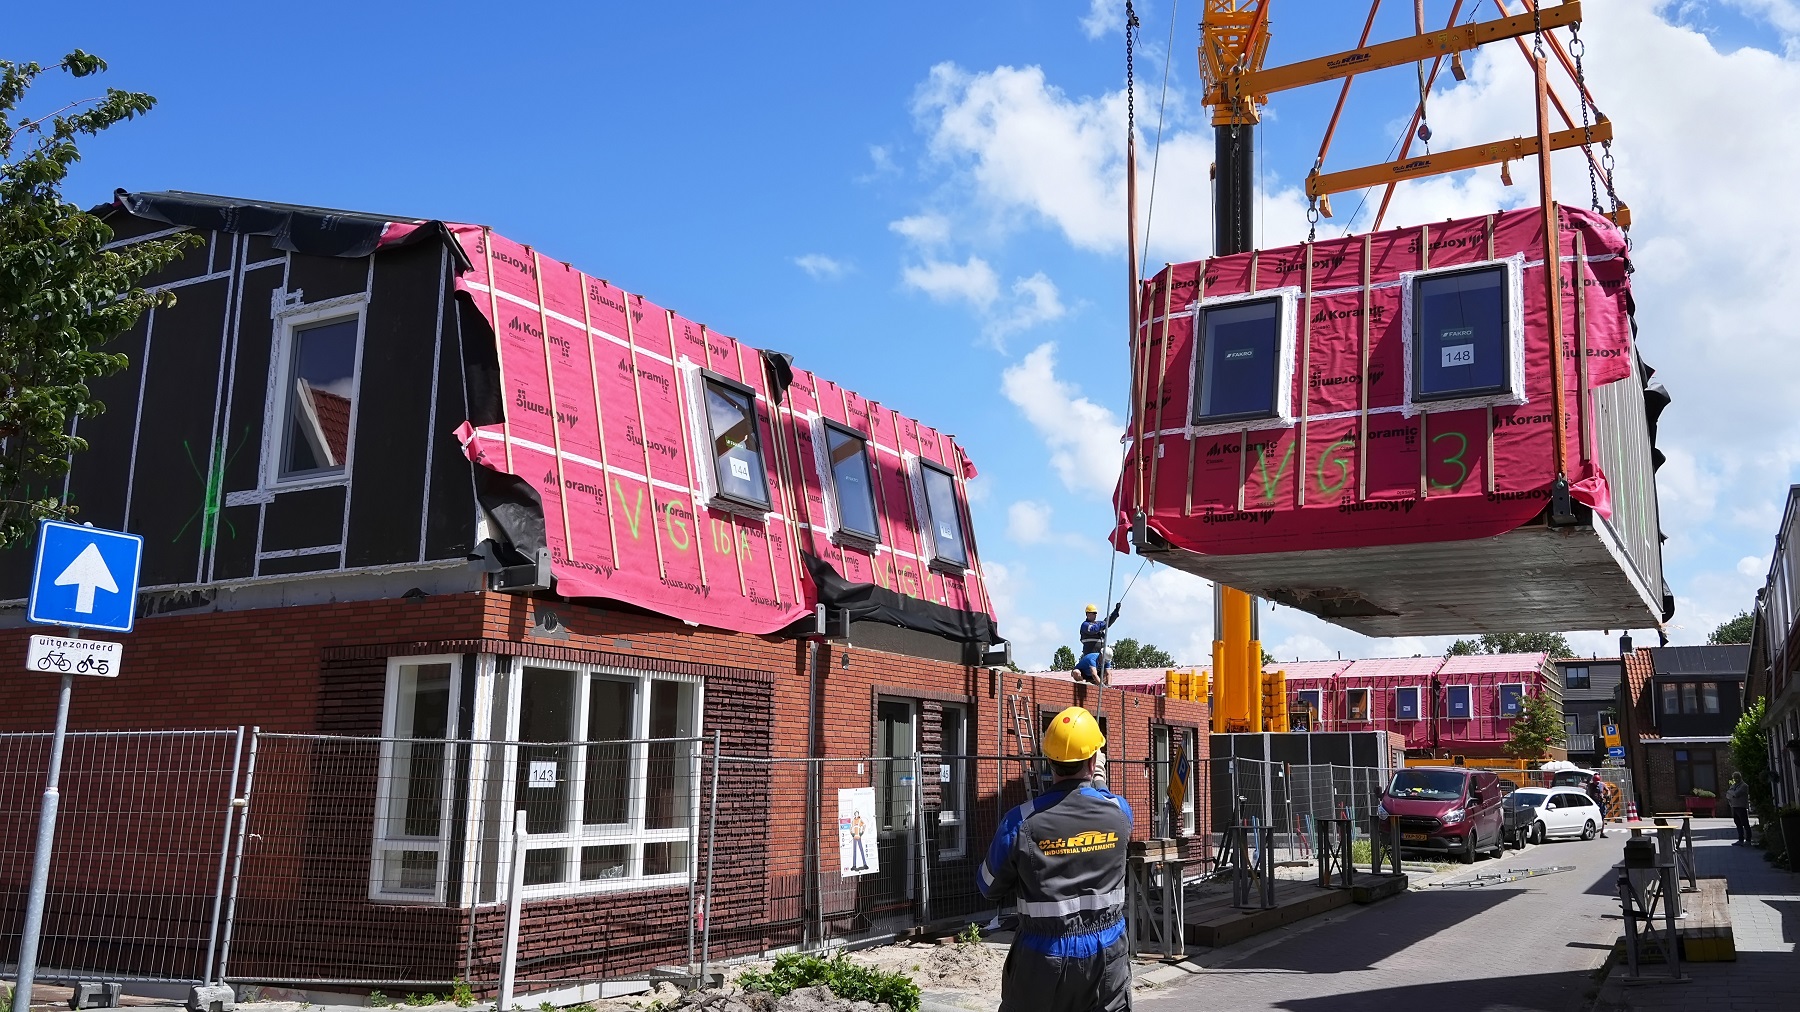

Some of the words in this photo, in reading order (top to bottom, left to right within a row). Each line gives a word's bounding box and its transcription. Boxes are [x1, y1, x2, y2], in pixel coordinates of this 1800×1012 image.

[1275, 260, 1330, 275] Koamic
[1232, 350, 1253, 358] FAKRO
[1445, 350, 1471, 363] 148
[1222, 439, 1278, 454] Koamic
[1431, 431, 1468, 489] 3
[733, 464, 748, 476] 144
[1338, 500, 1399, 515] Koramic
[1202, 511, 1259, 526] Koramic
[39, 637, 113, 652] uitgezonderd
[533, 769, 554, 781] 143
[1067, 831, 1119, 848] RIEL
[1044, 848, 1081, 856] INDUSTRIAL
[1081, 843, 1116, 853] MOVEMENTS
